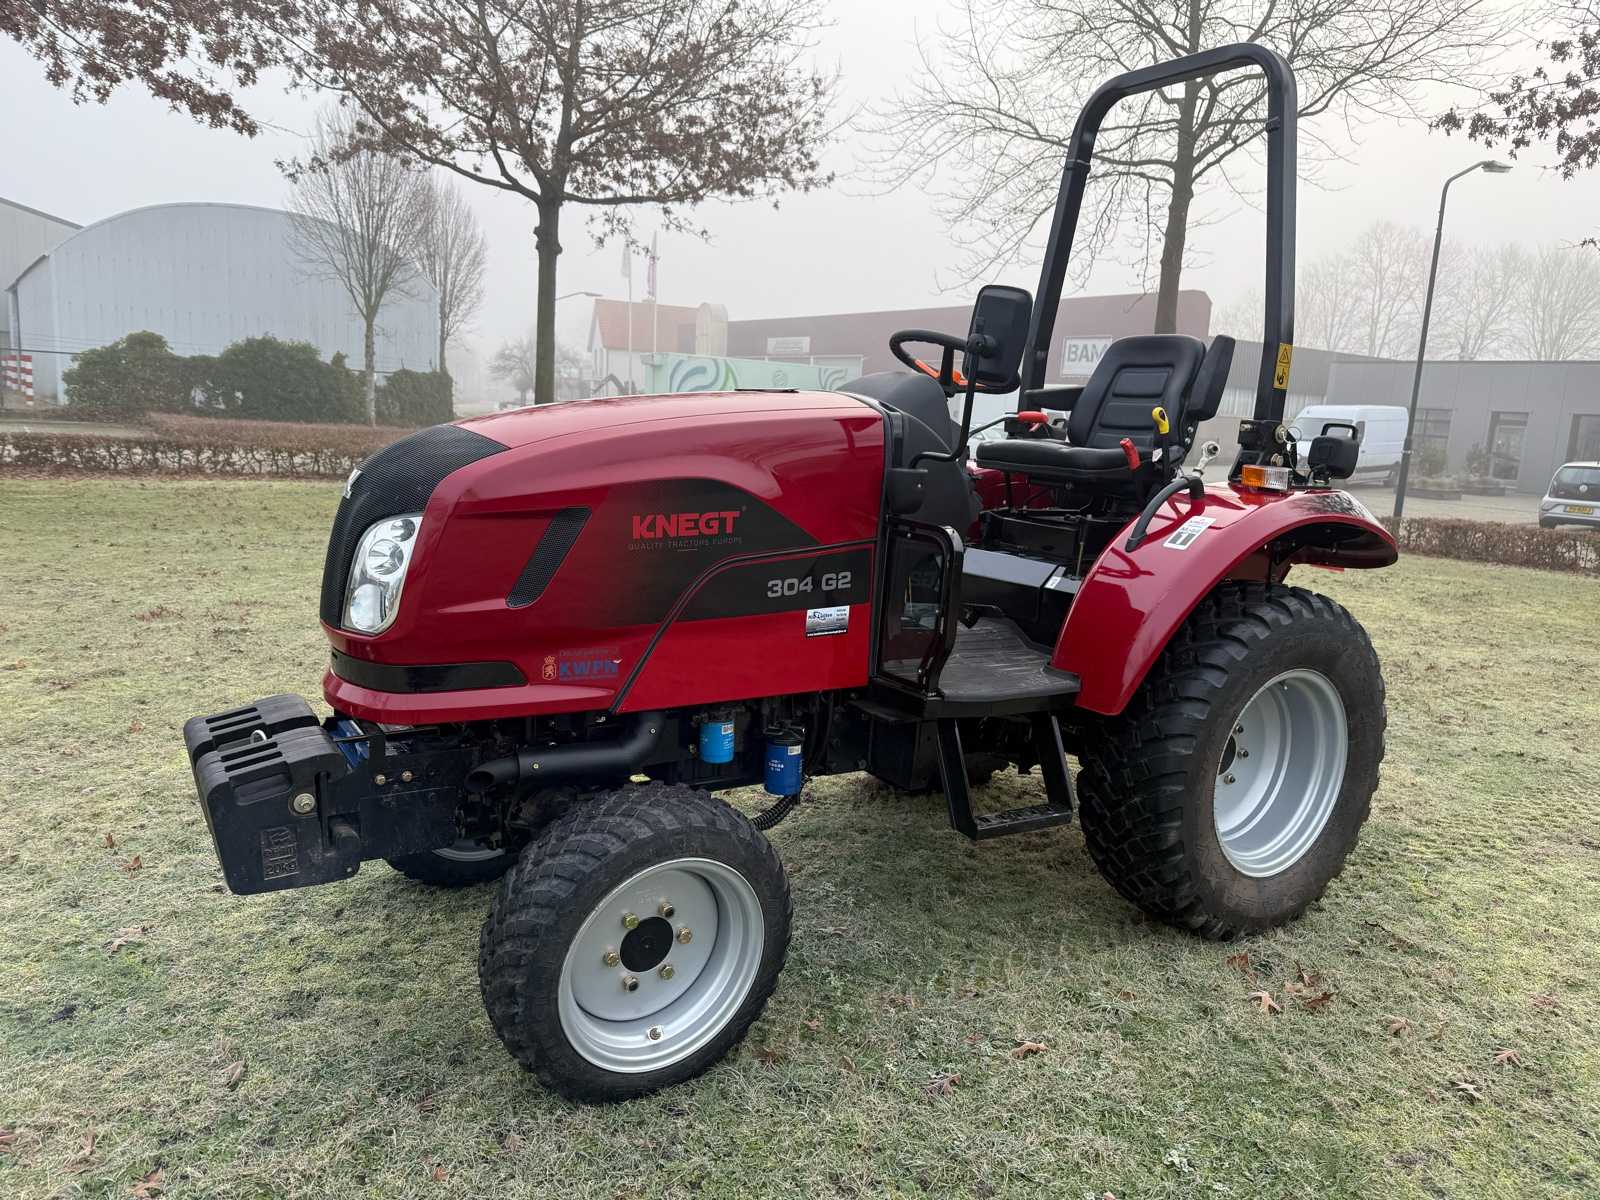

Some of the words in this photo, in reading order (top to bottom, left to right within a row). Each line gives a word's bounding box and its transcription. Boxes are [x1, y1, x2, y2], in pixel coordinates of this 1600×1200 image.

[1067, 343, 1109, 363] BAM
[632, 511, 740, 539] KNEGT
[628, 541, 664, 551] QUALITY
[767, 576, 813, 598] 304
[821, 571, 852, 591] G2
